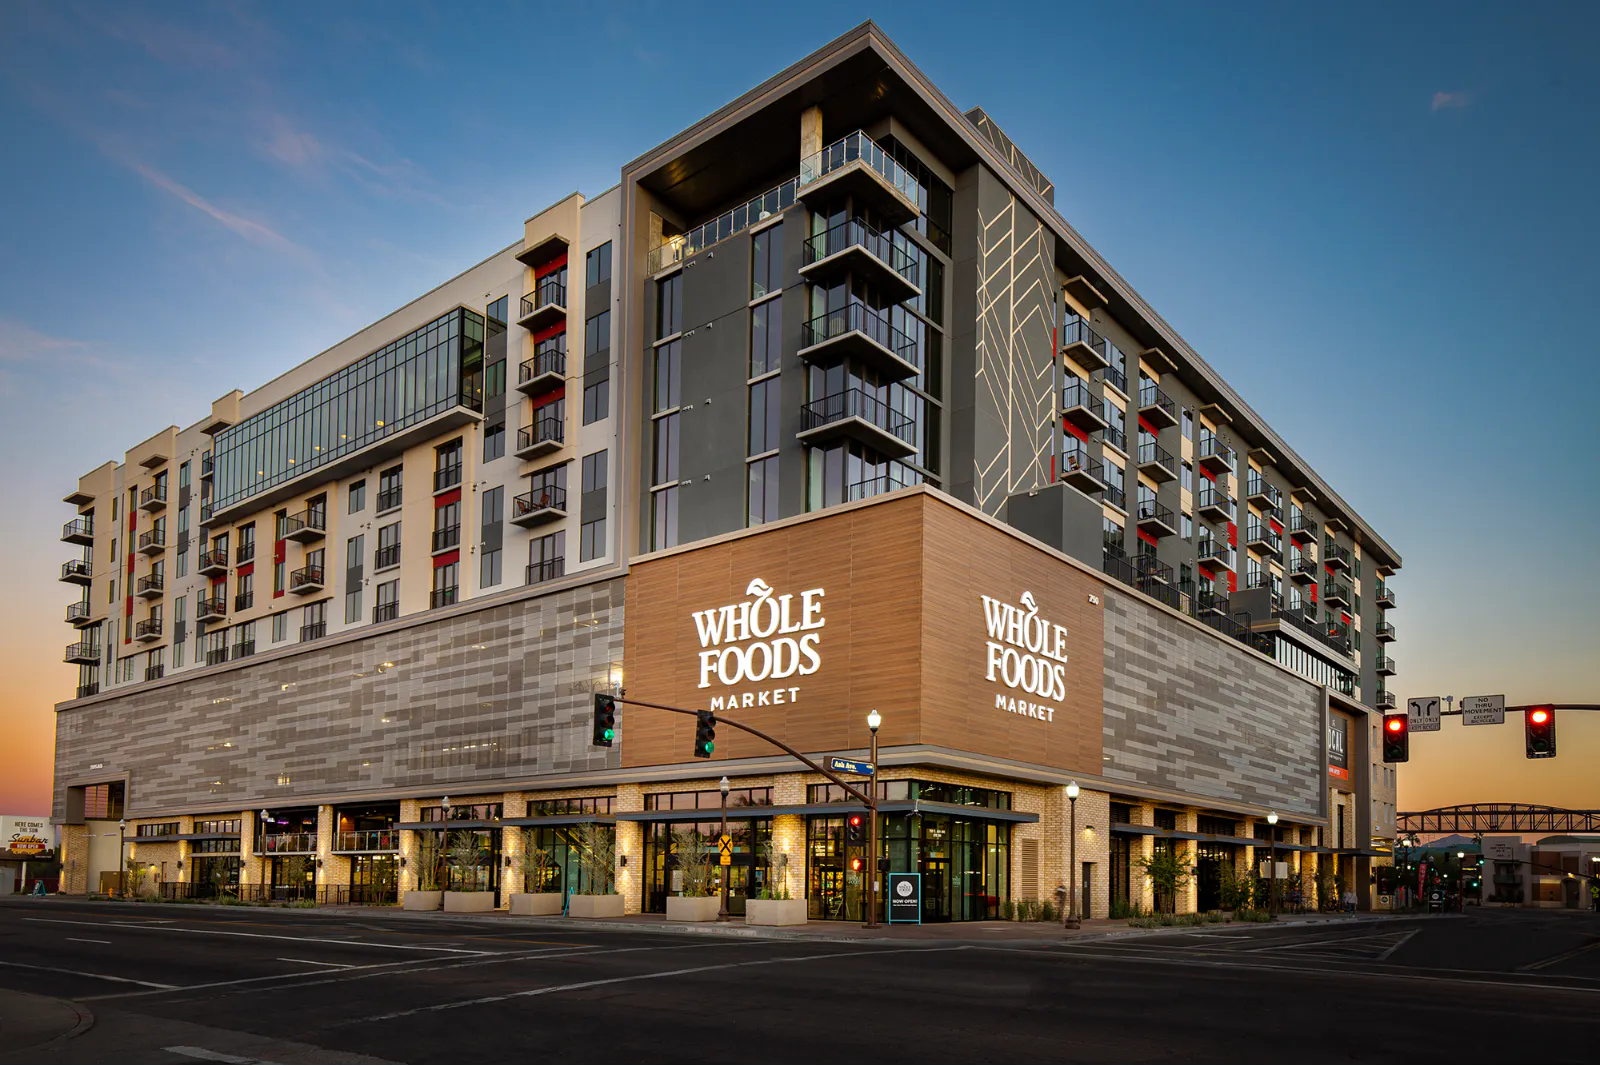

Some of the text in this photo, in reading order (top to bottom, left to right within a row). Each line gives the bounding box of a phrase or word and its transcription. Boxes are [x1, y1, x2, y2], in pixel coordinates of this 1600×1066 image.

[692, 578, 825, 648] WHOLE
[981, 591, 1068, 664] WHOLE
[698, 633, 821, 689] FOODS
[985, 641, 1066, 702] FOODS
[710, 687, 800, 711] MARKET
[995, 694, 1055, 722] MARKET
[834, 760, 845, 768] Ash
[845, 762, 857, 770] Ave.
[8, 833, 48, 843] Sunbar
